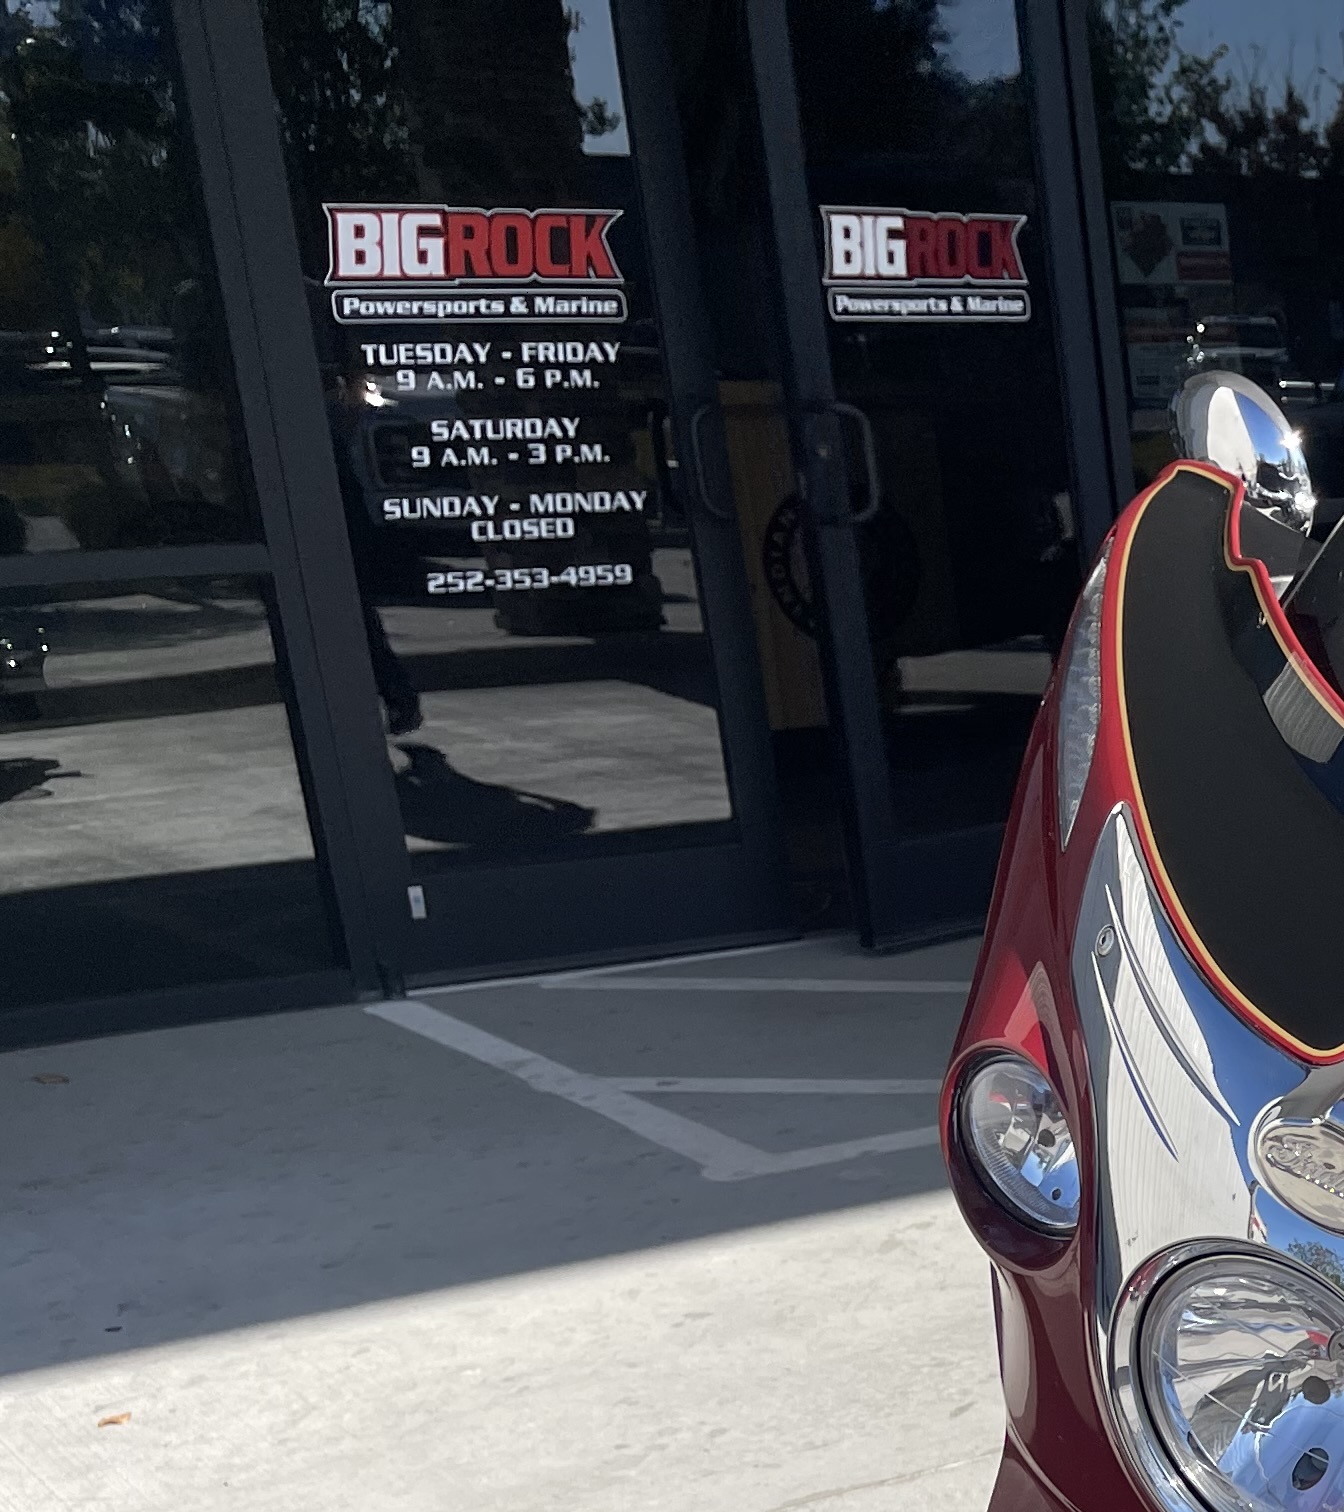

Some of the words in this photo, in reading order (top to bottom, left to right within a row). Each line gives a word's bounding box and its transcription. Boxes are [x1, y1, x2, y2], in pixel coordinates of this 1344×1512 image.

[343, 297, 504, 317] Powersports
[509, 297, 529, 315] &
[534, 296, 619, 316] Marine
[835, 294, 948, 316] Powersports
[949, 295, 963, 312] &
[966, 295, 1024, 313] Marine
[361, 342, 491, 366] TUESDAY
[521, 341, 621, 364] FRIDAY
[396, 370, 415, 391] 9
[427, 371, 484, 391] A.M.
[516, 368, 535, 389] 6
[545, 368, 600, 389] P.M.
[431, 417, 580, 442] SATURDAY
[411, 446, 430, 468] 9
[441, 446, 498, 467] A.M.
[528, 444, 547, 465] 3
[555, 444, 611, 464] P.M.
[383, 495, 499, 521] SUNDAY
[529, 490, 647, 515] MONDAY
[471, 517, 575, 542] CLOSED
[427, 564, 633, 594] 252-353-4959
